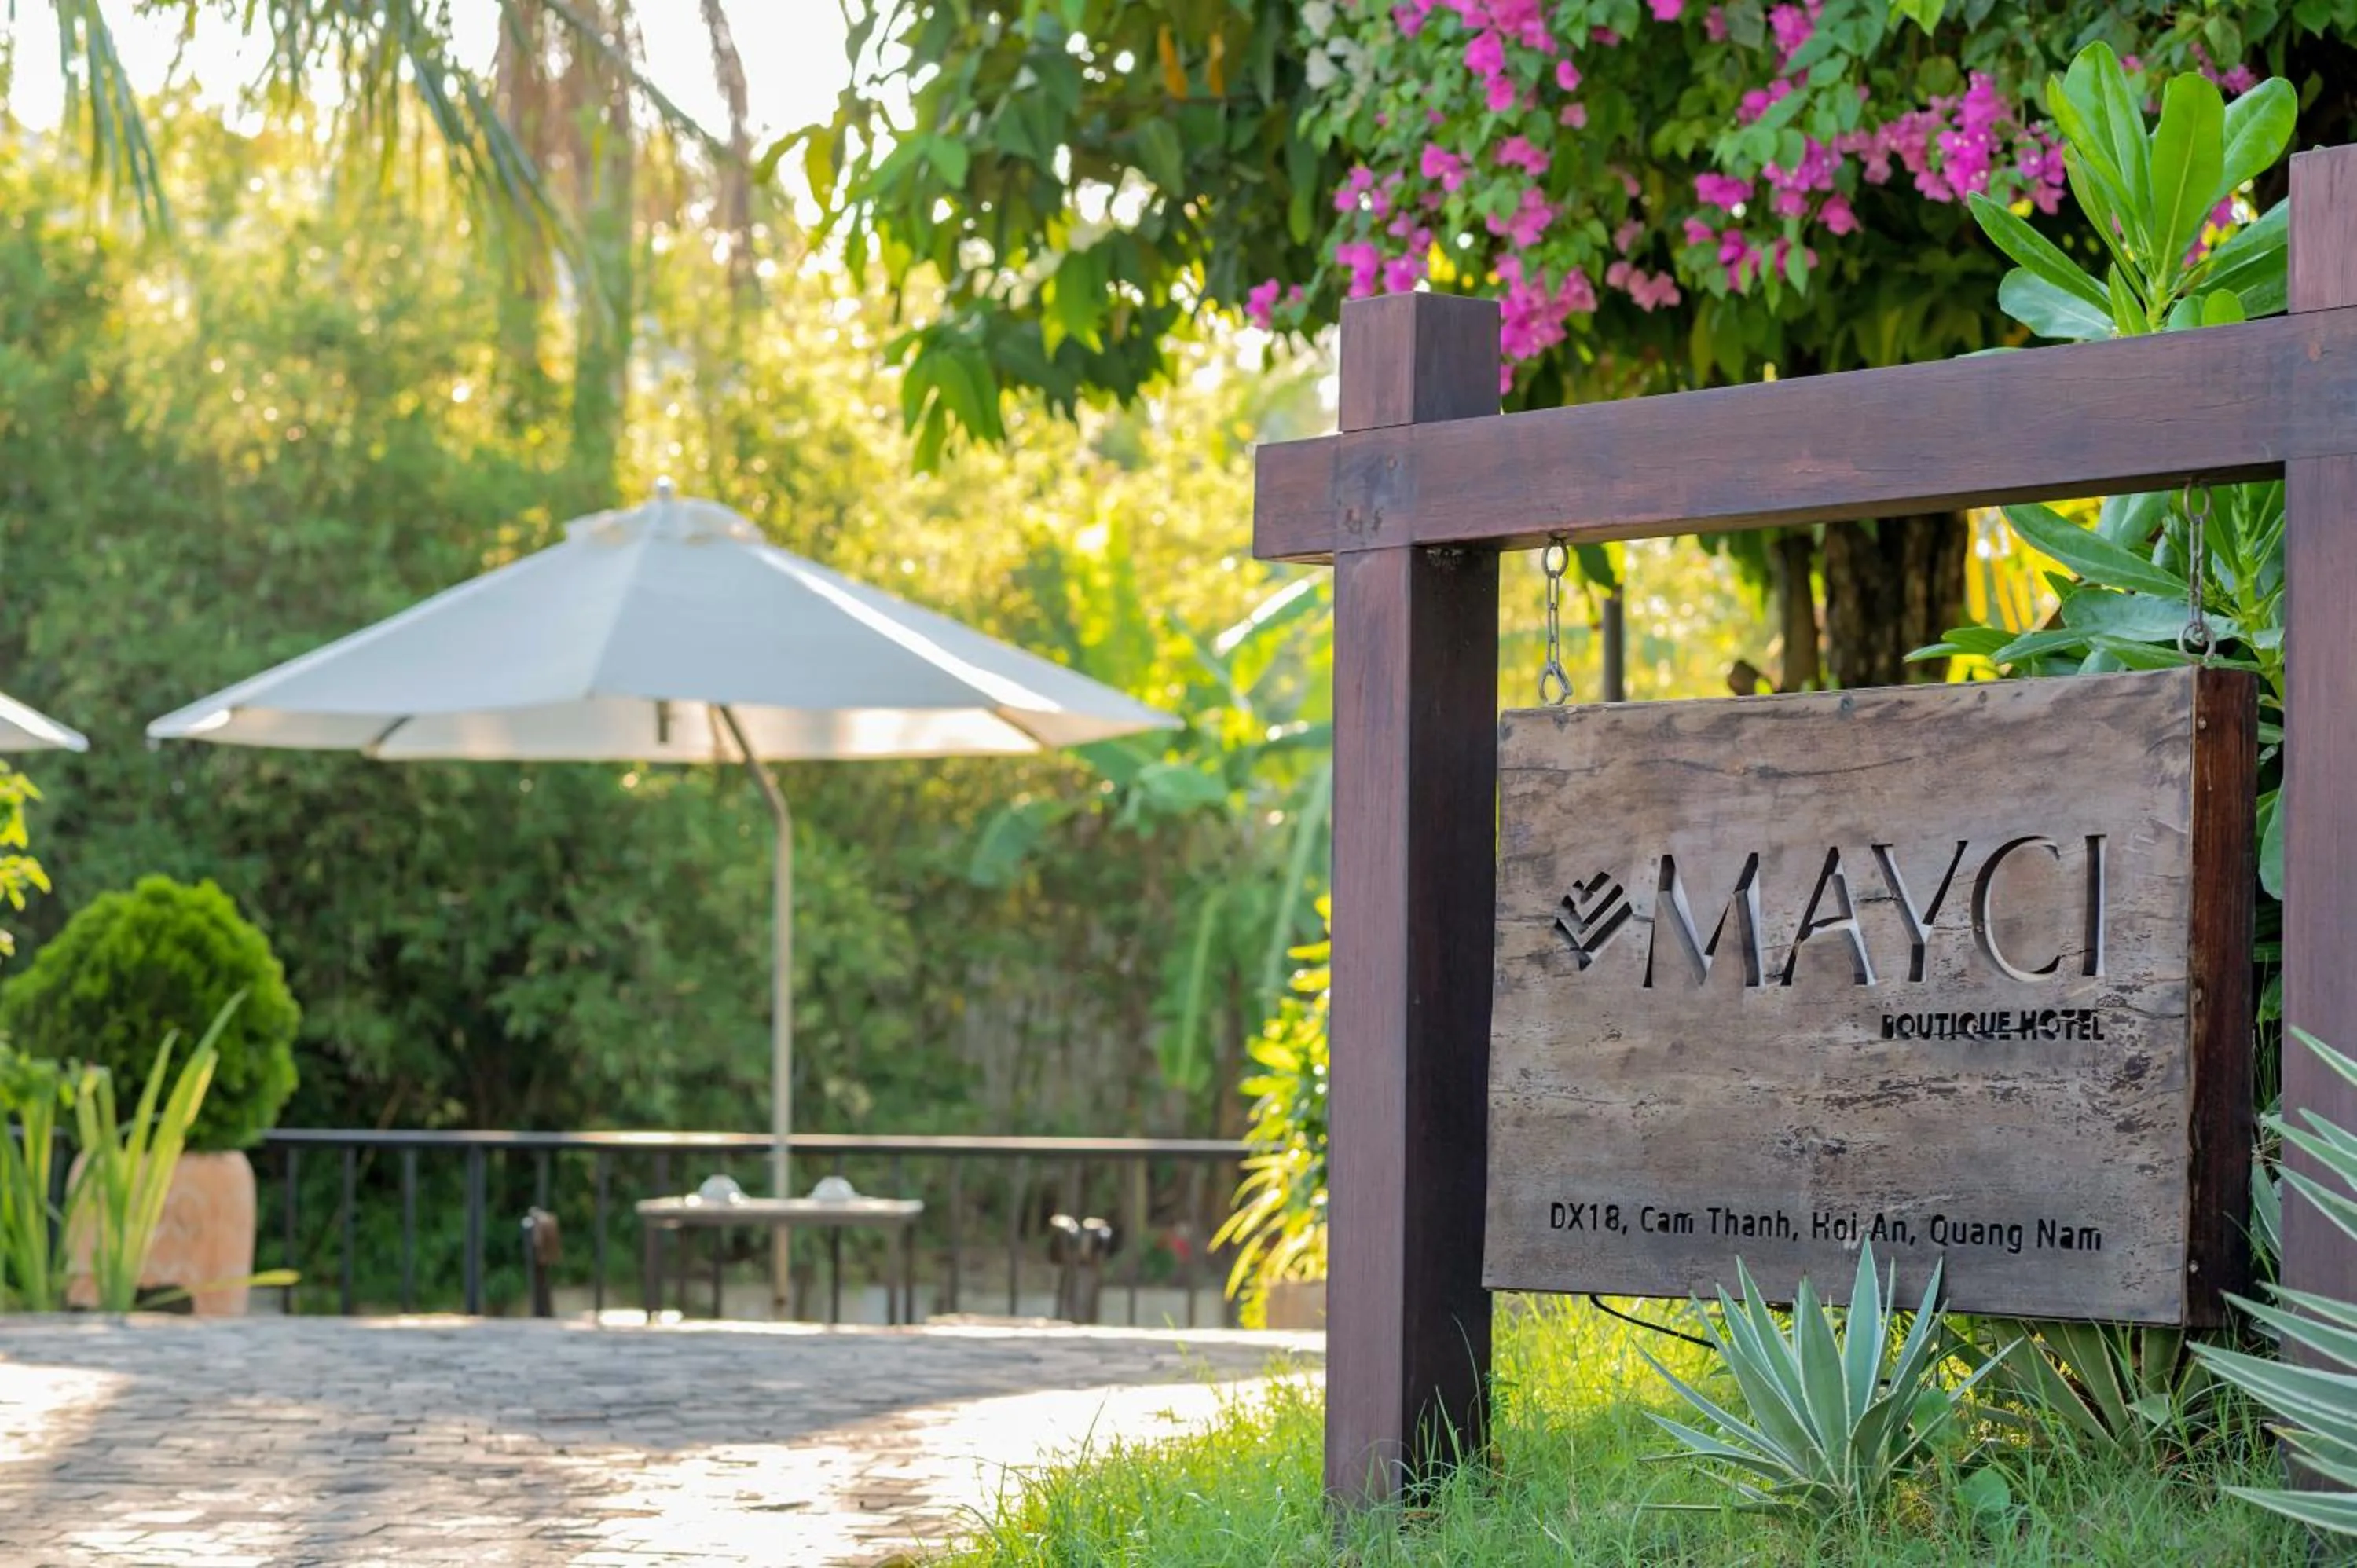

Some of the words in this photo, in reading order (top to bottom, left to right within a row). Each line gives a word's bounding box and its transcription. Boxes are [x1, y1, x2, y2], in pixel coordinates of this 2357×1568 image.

[1642, 833, 2109, 989] MAYCI
[1881, 1012, 2011, 1041] BOUTIQUE
[2020, 1009, 2105, 1042] HOTEL
[1549, 1202, 1629, 1235] DX18,
[1640, 1206, 1694, 1235] Cam
[1706, 1207, 1799, 1241] Thanh,
[1812, 1211, 1857, 1241] Hoi
[1869, 1212, 1916, 1247] An,
[1930, 1214, 2023, 1255] Quang
[2036, 1218, 2102, 1252] Nam
